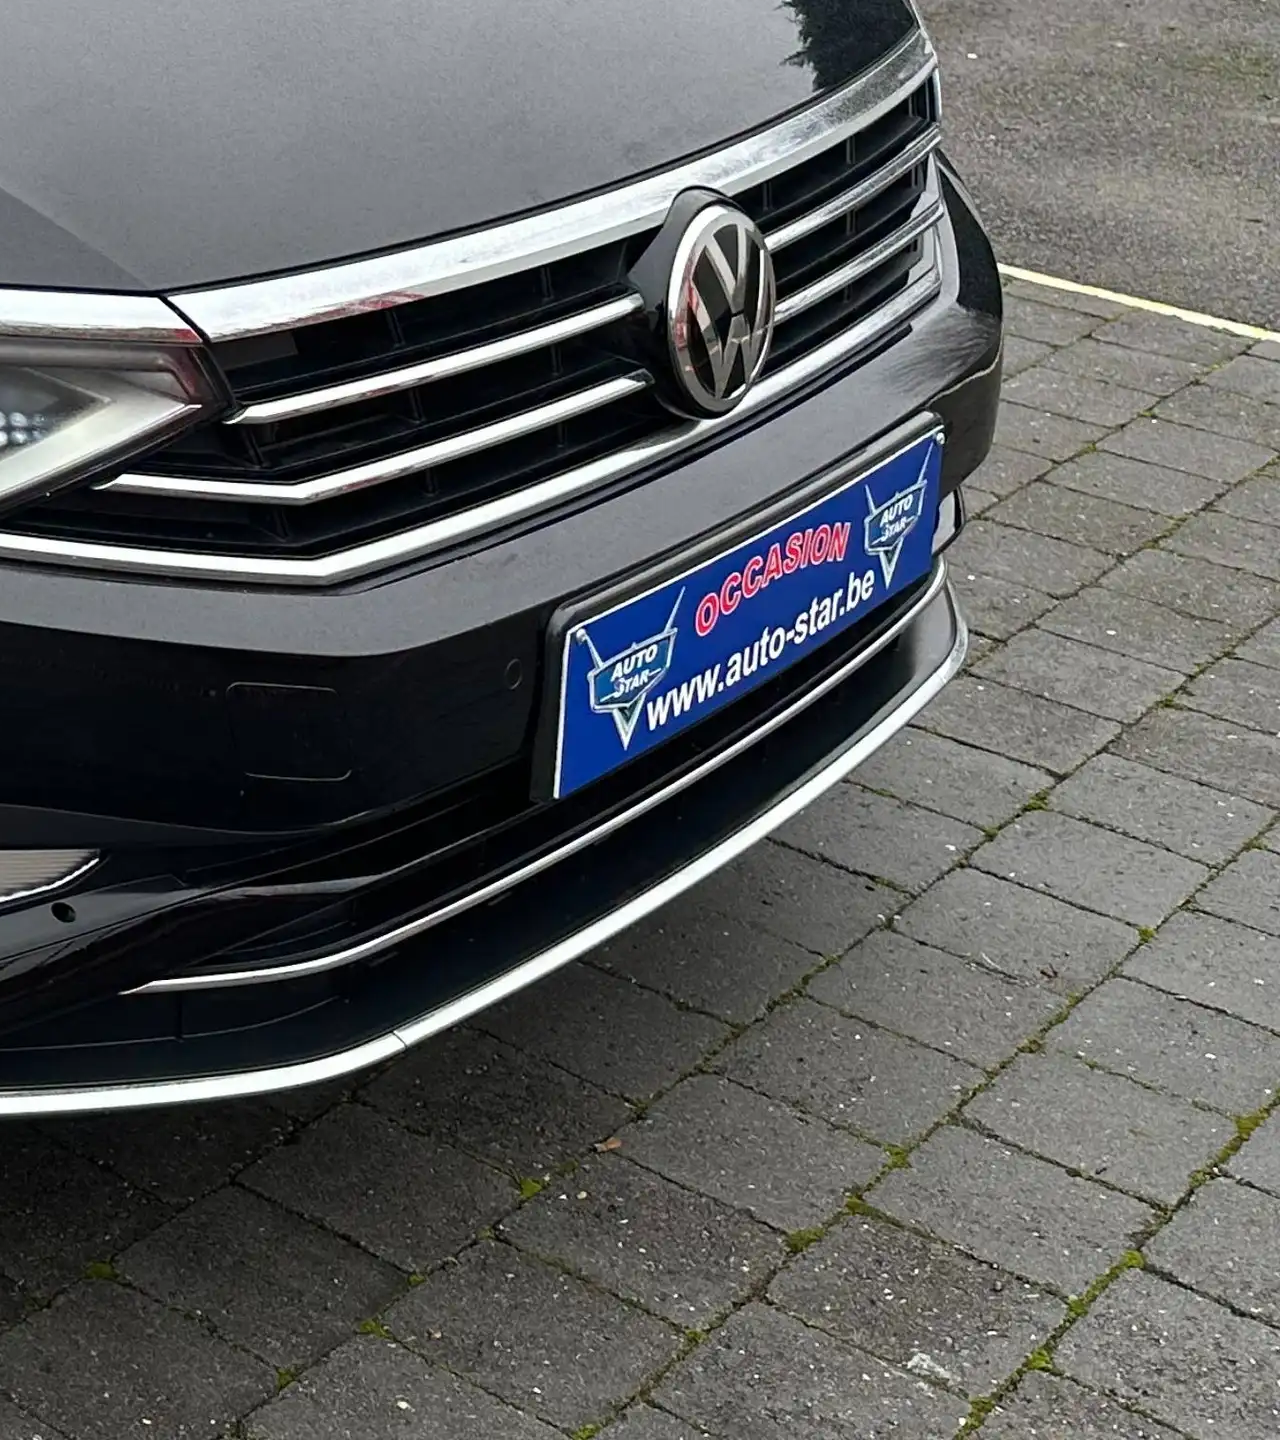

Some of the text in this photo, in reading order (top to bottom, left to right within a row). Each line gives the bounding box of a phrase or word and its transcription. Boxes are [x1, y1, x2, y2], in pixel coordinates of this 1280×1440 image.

[879, 493, 914, 525] AUTO
[881, 517, 907, 542] STAR
[695, 521, 852, 638] OCCASION
[610, 643, 659, 682] AUTO
[646, 568, 876, 732] www.auto-star.be
[613, 669, 650, 697] STAR
